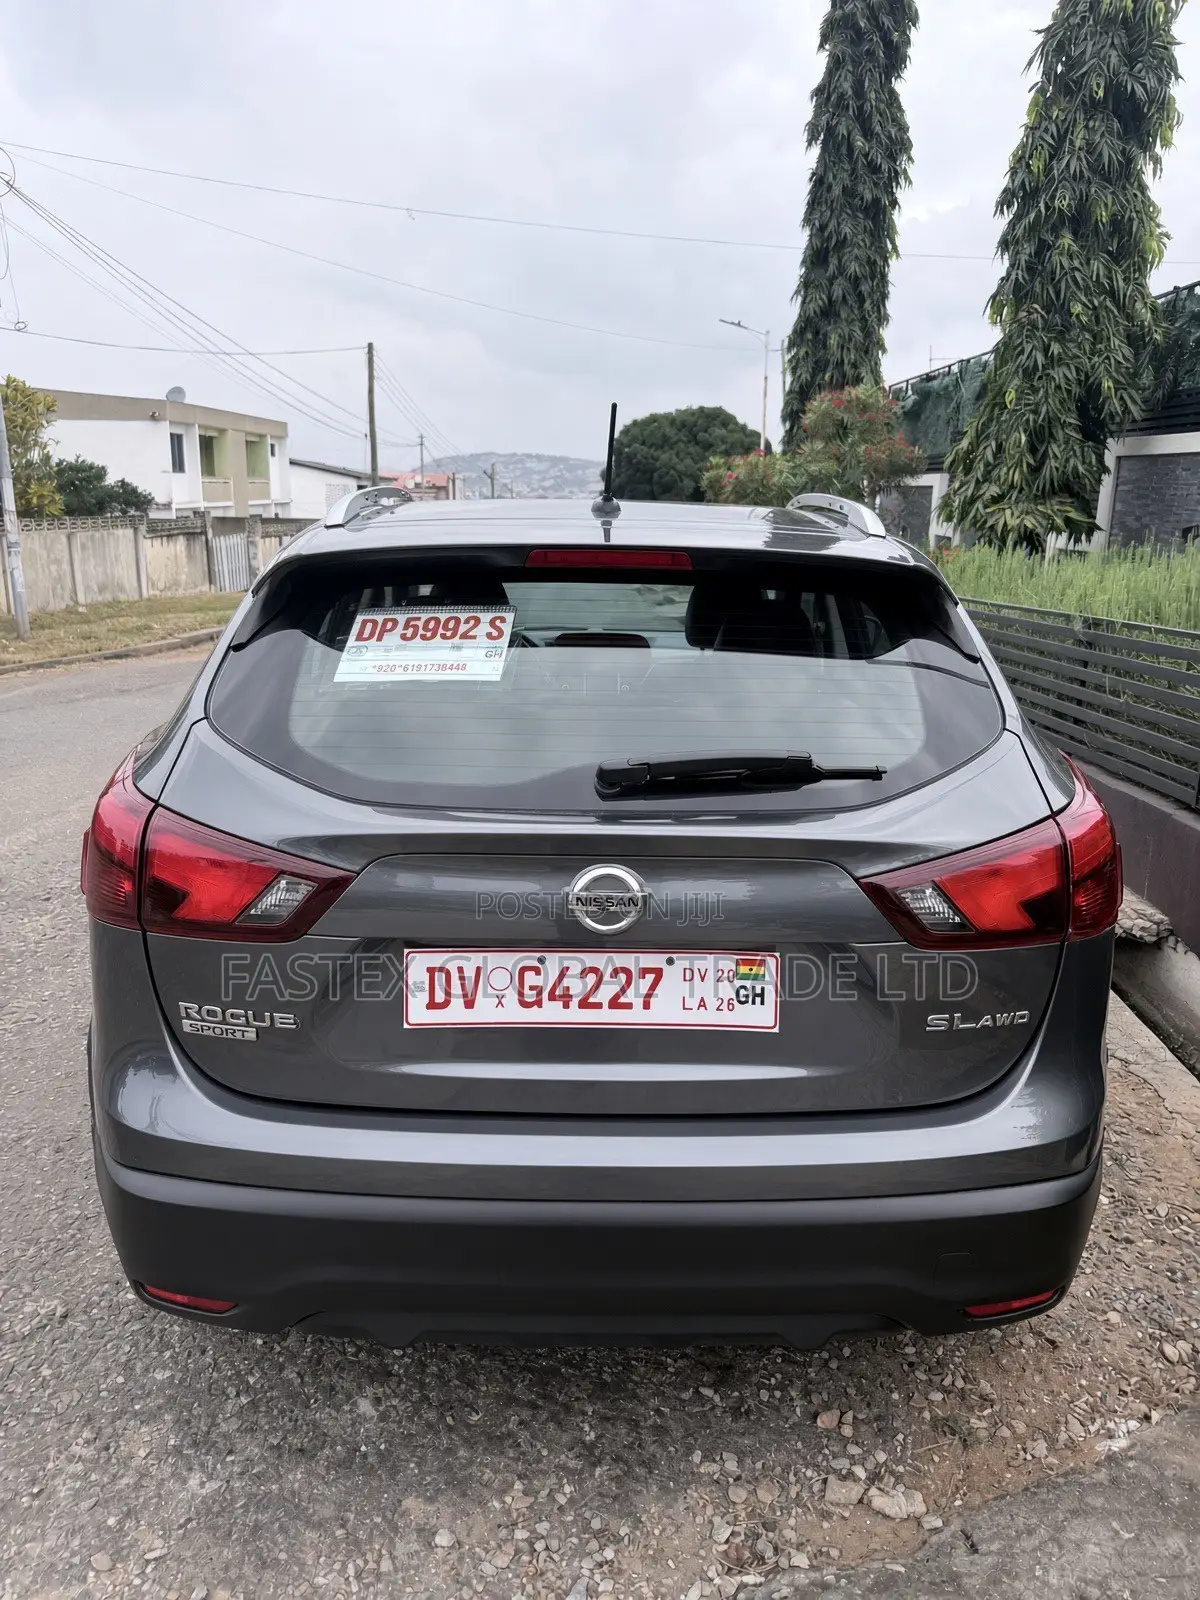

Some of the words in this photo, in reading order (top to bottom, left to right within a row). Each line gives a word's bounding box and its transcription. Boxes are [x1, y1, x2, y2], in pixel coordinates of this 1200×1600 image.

[354, 617, 399, 642] DP
[399, 615, 481, 642] 5992
[485, 615, 507, 641] S
[575, 896, 639, 909] NISSAN
[682, 967, 709, 984] DV
[716, 968, 737, 984] 20
[425, 965, 483, 1011] DV
[517, 965, 664, 1011] G4227
[735, 984, 766, 1006] GH
[682, 996, 708, 1011] LA
[715, 997, 736, 1012] 26
[178, 1001, 300, 1030] ROGUE
[188, 1022, 250, 1039] SPORT
